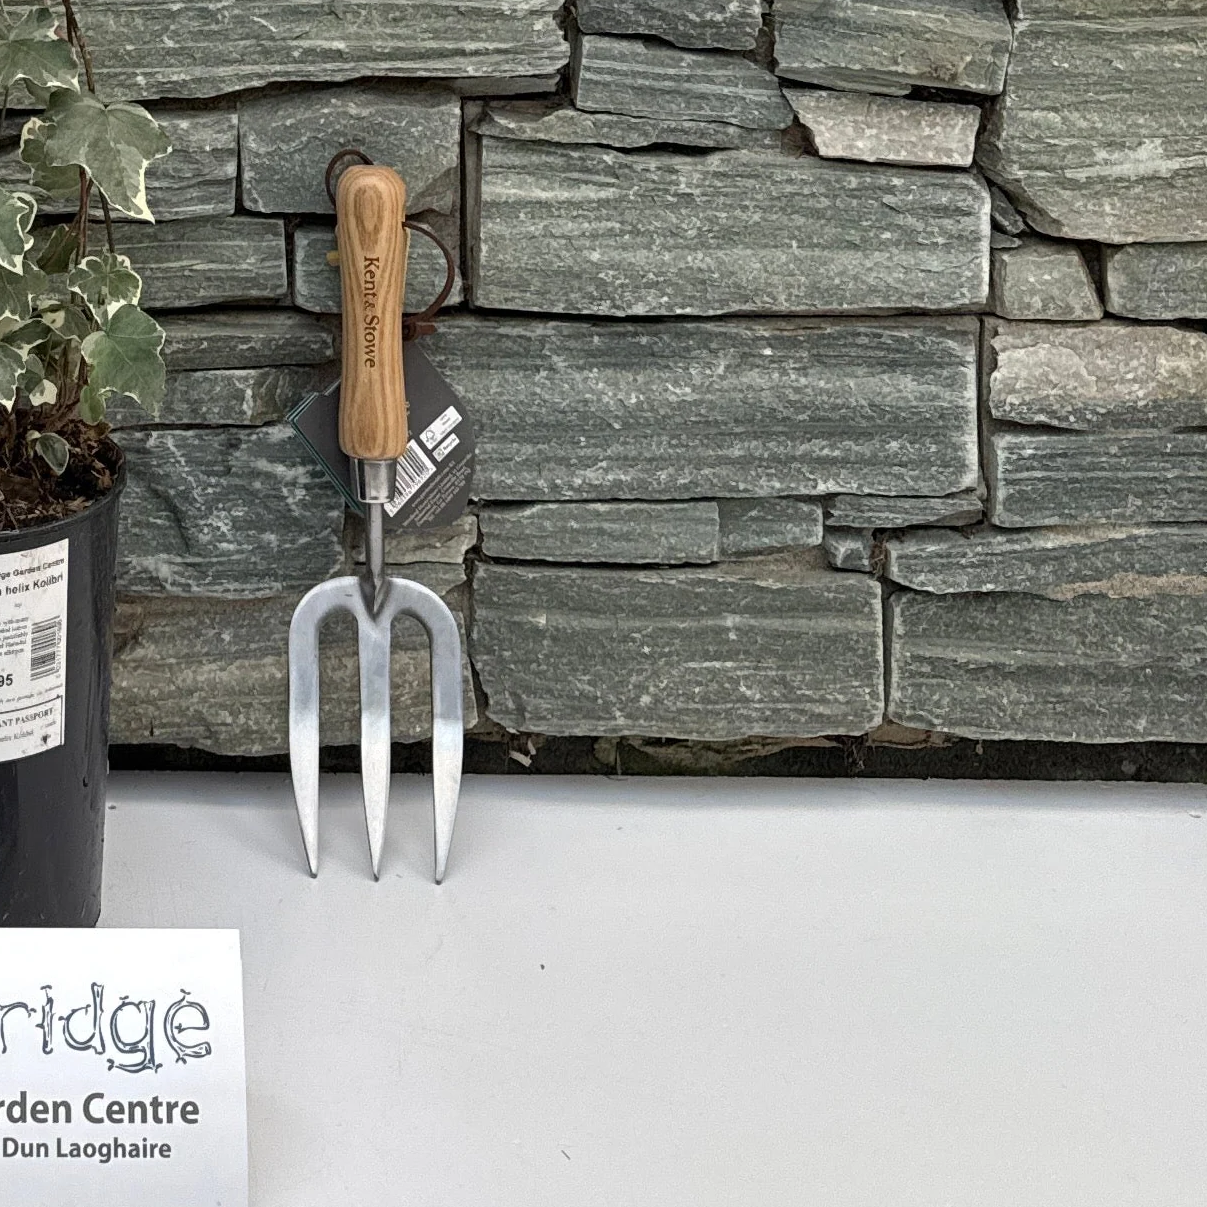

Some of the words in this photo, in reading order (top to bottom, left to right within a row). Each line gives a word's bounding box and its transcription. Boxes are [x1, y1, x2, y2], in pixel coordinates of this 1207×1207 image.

[363, 255, 380, 299] Kent
[363, 300, 376, 312] &
[363, 314, 380, 369] Stowe
[5, 582, 30, 595] helix
[32, 571, 64, 591] Kolibri
[12, 565, 41, 577] Garden
[15, 707, 54, 726] PASSPORT
[82, 1092, 200, 1125] Centre
[2, 1136, 49, 1159] Dun
[56, 1136, 172, 1164] Laoghaire
